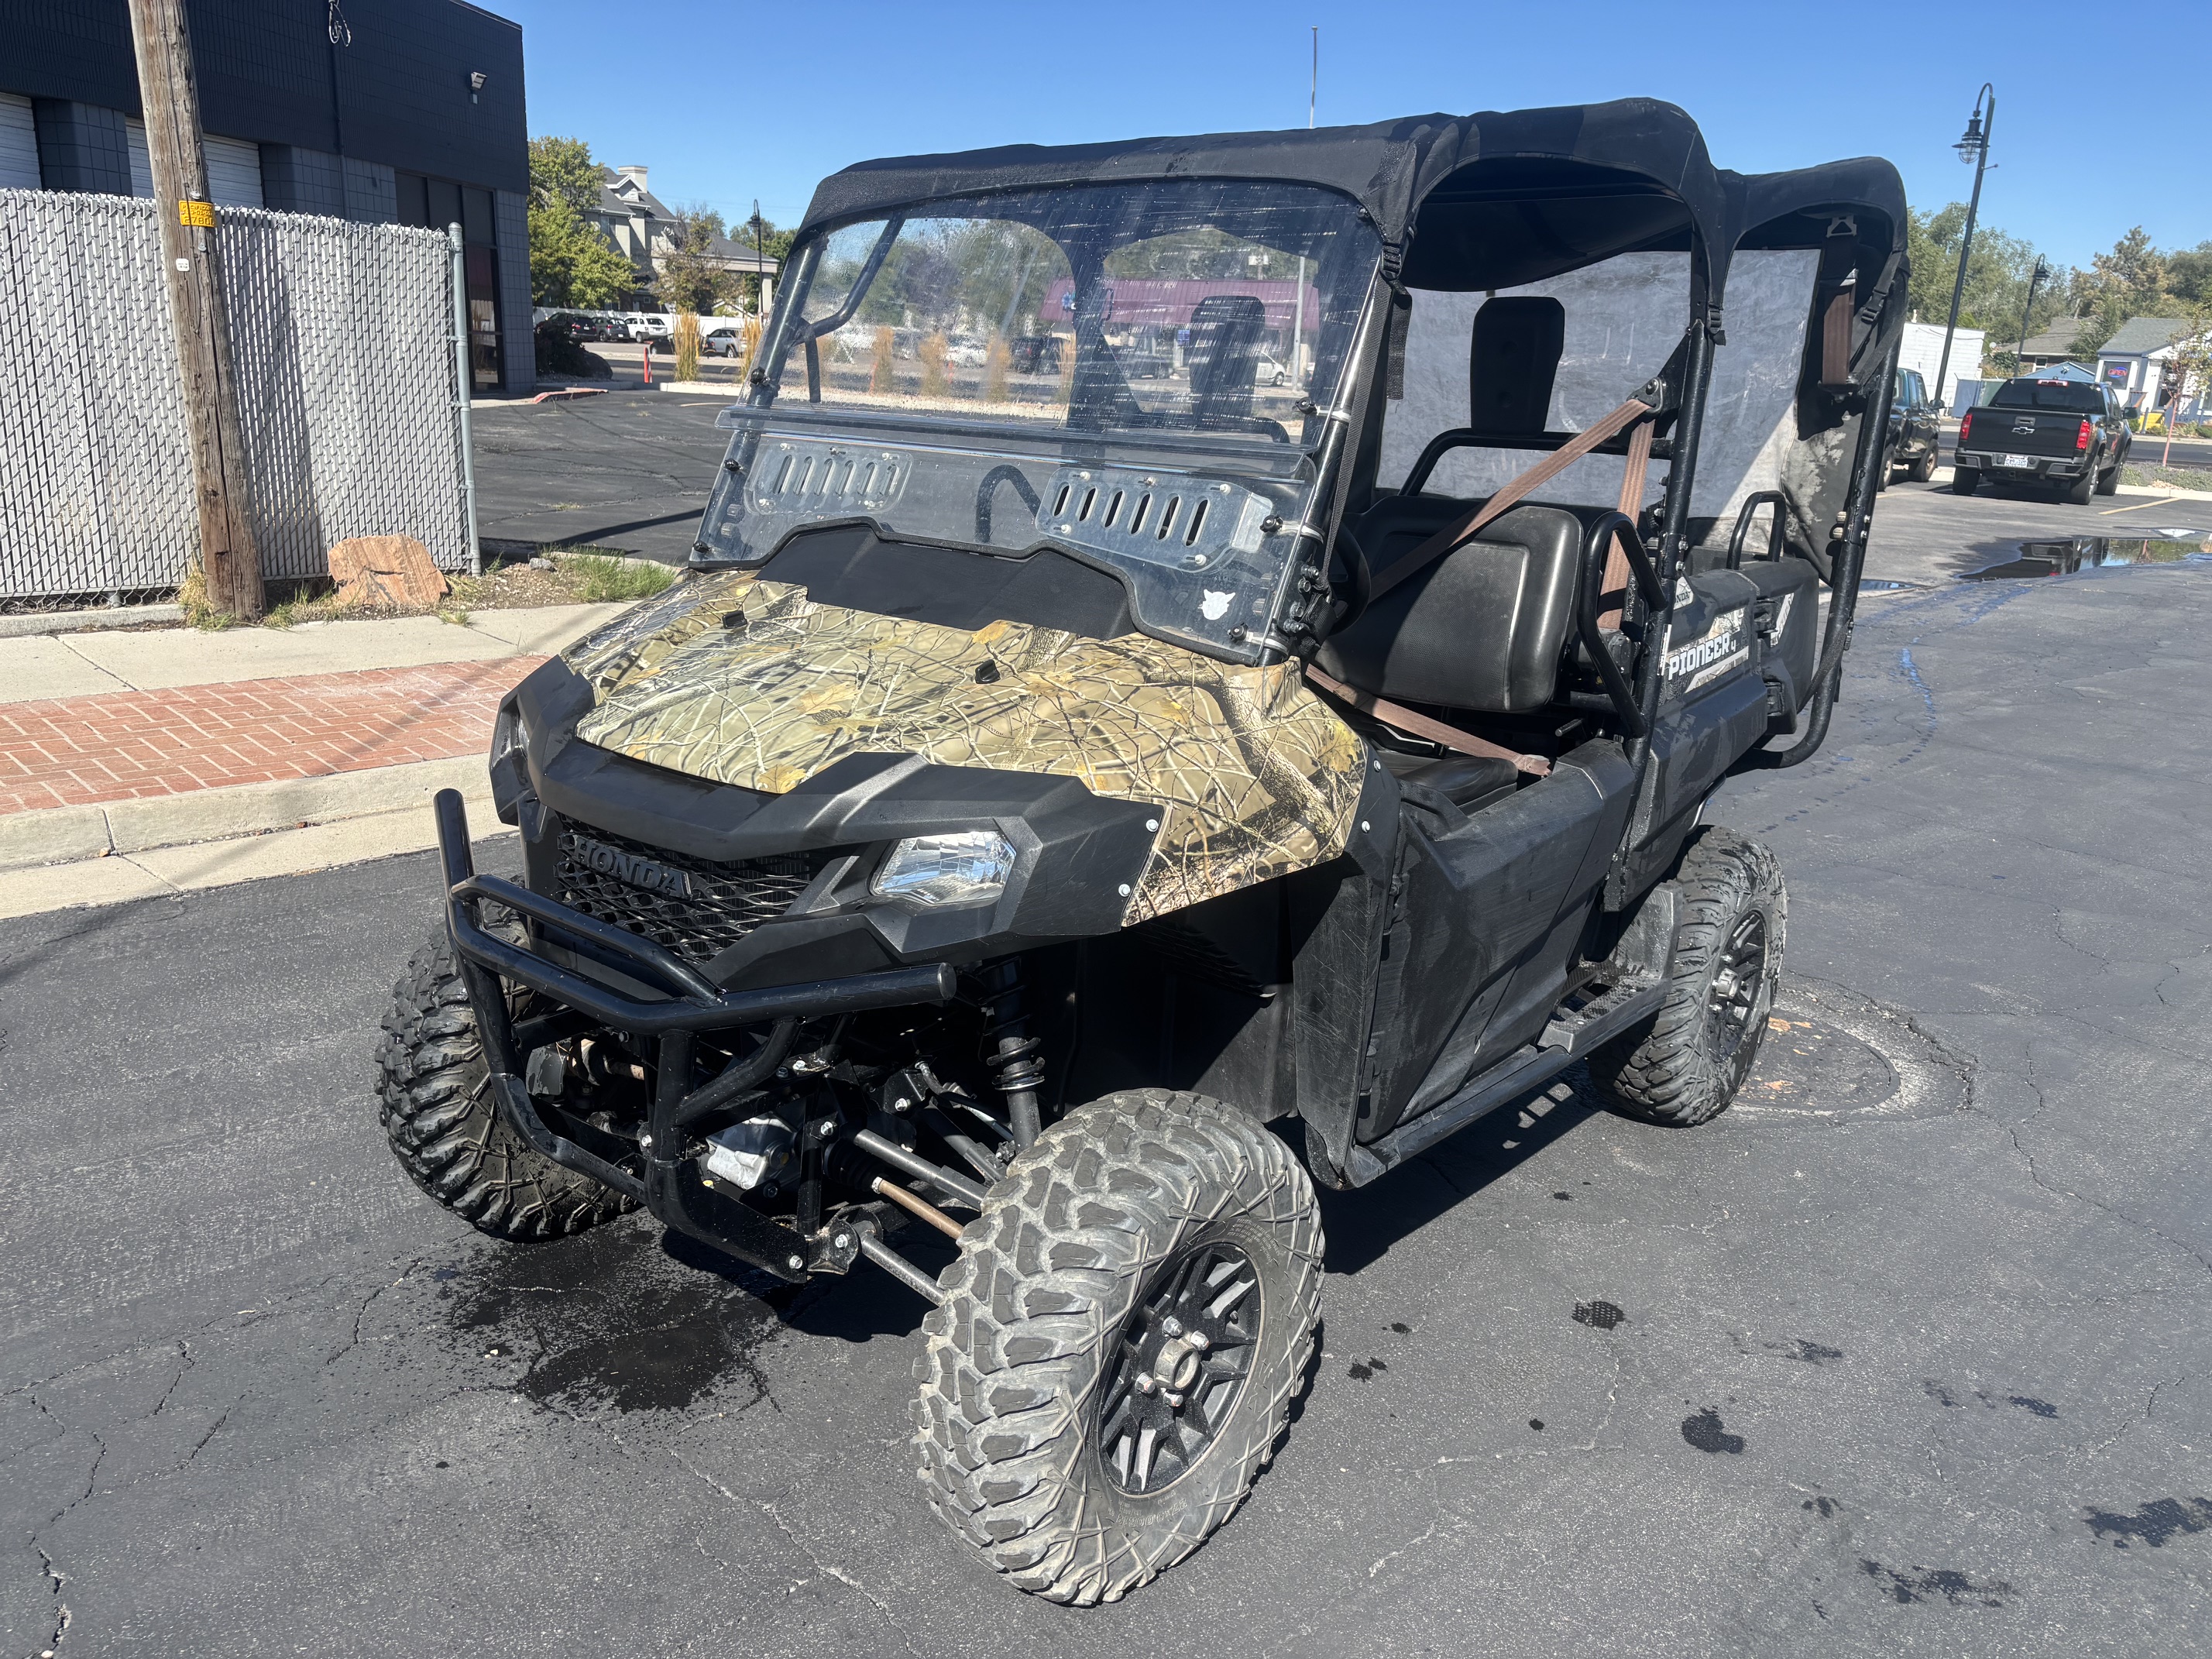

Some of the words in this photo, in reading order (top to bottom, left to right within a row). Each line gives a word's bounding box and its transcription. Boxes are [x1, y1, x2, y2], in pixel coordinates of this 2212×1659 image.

[1676, 591, 1691, 603] NDA
[1668, 631, 1729, 680] PIONEER
[1731, 640, 1736, 652] 4
[575, 835, 691, 900] HONDA
